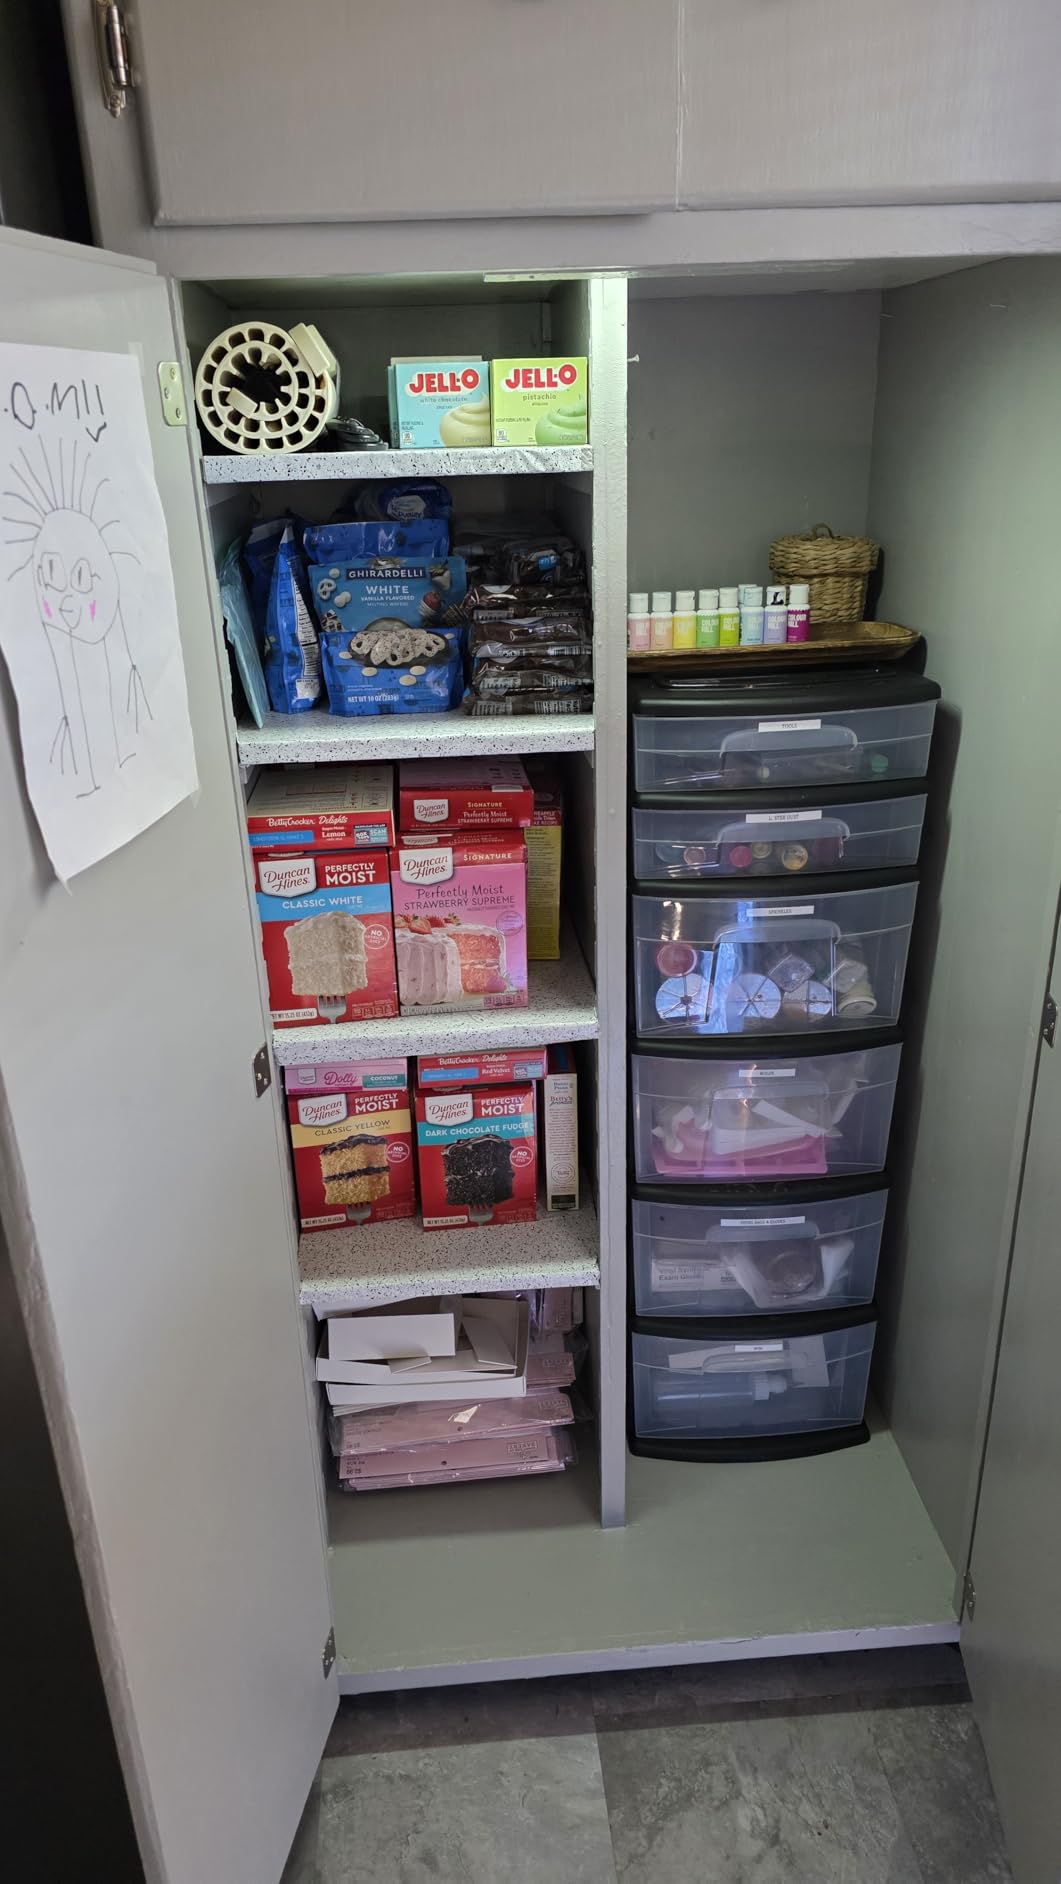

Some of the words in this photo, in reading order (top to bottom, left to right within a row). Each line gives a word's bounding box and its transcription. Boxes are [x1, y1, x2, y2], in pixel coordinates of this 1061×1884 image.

[523, 393, 556, 401] pistachio
[349, 569, 423, 578] GHIRARDELLI
[365, 585, 409, 594] WHITE
[416, 803, 446, 814] Duncan
[421, 810, 444, 818] Hines
[318, 815, 348, 824] Delights
[404, 856, 448, 872] Duncan
[463, 852, 512, 862] SIGNATURE
[324, 862, 375, 873] PERFECTLY
[410, 866, 446, 880] Hines
[264, 866, 310, 884] Duncan
[326, 870, 376, 886] MOIST
[272, 877, 308, 892] Hines
[416, 885, 468, 900] Perfectly
[472, 884, 504, 895] Moist
[282, 898, 326, 910] CLASSIC
[328, 896, 363, 904] WHITE
[404, 898, 469, 911] STRAWBERRY
[472, 896, 515, 906] SUPREME
[324, 1071, 358, 1086] Dolly
[354, 1093, 398, 1103] PERFECTLY
[481, 1096, 524, 1106] PERFECTLY
[302, 1101, 342, 1116] Duncan
[355, 1099, 398, 1114] MOIST
[429, 1100, 469, 1114] Duncan
[481, 1104, 524, 1116] MOIST
[308, 1109, 340, 1123] Hines
[435, 1109, 466, 1122] Hines
[314, 1126, 352, 1136] CLASSIC
[354, 1120, 390, 1130] YELLOW
[450, 1126, 500, 1136] CHOCOLATE
[502, 1122, 529, 1132] FUDGE
